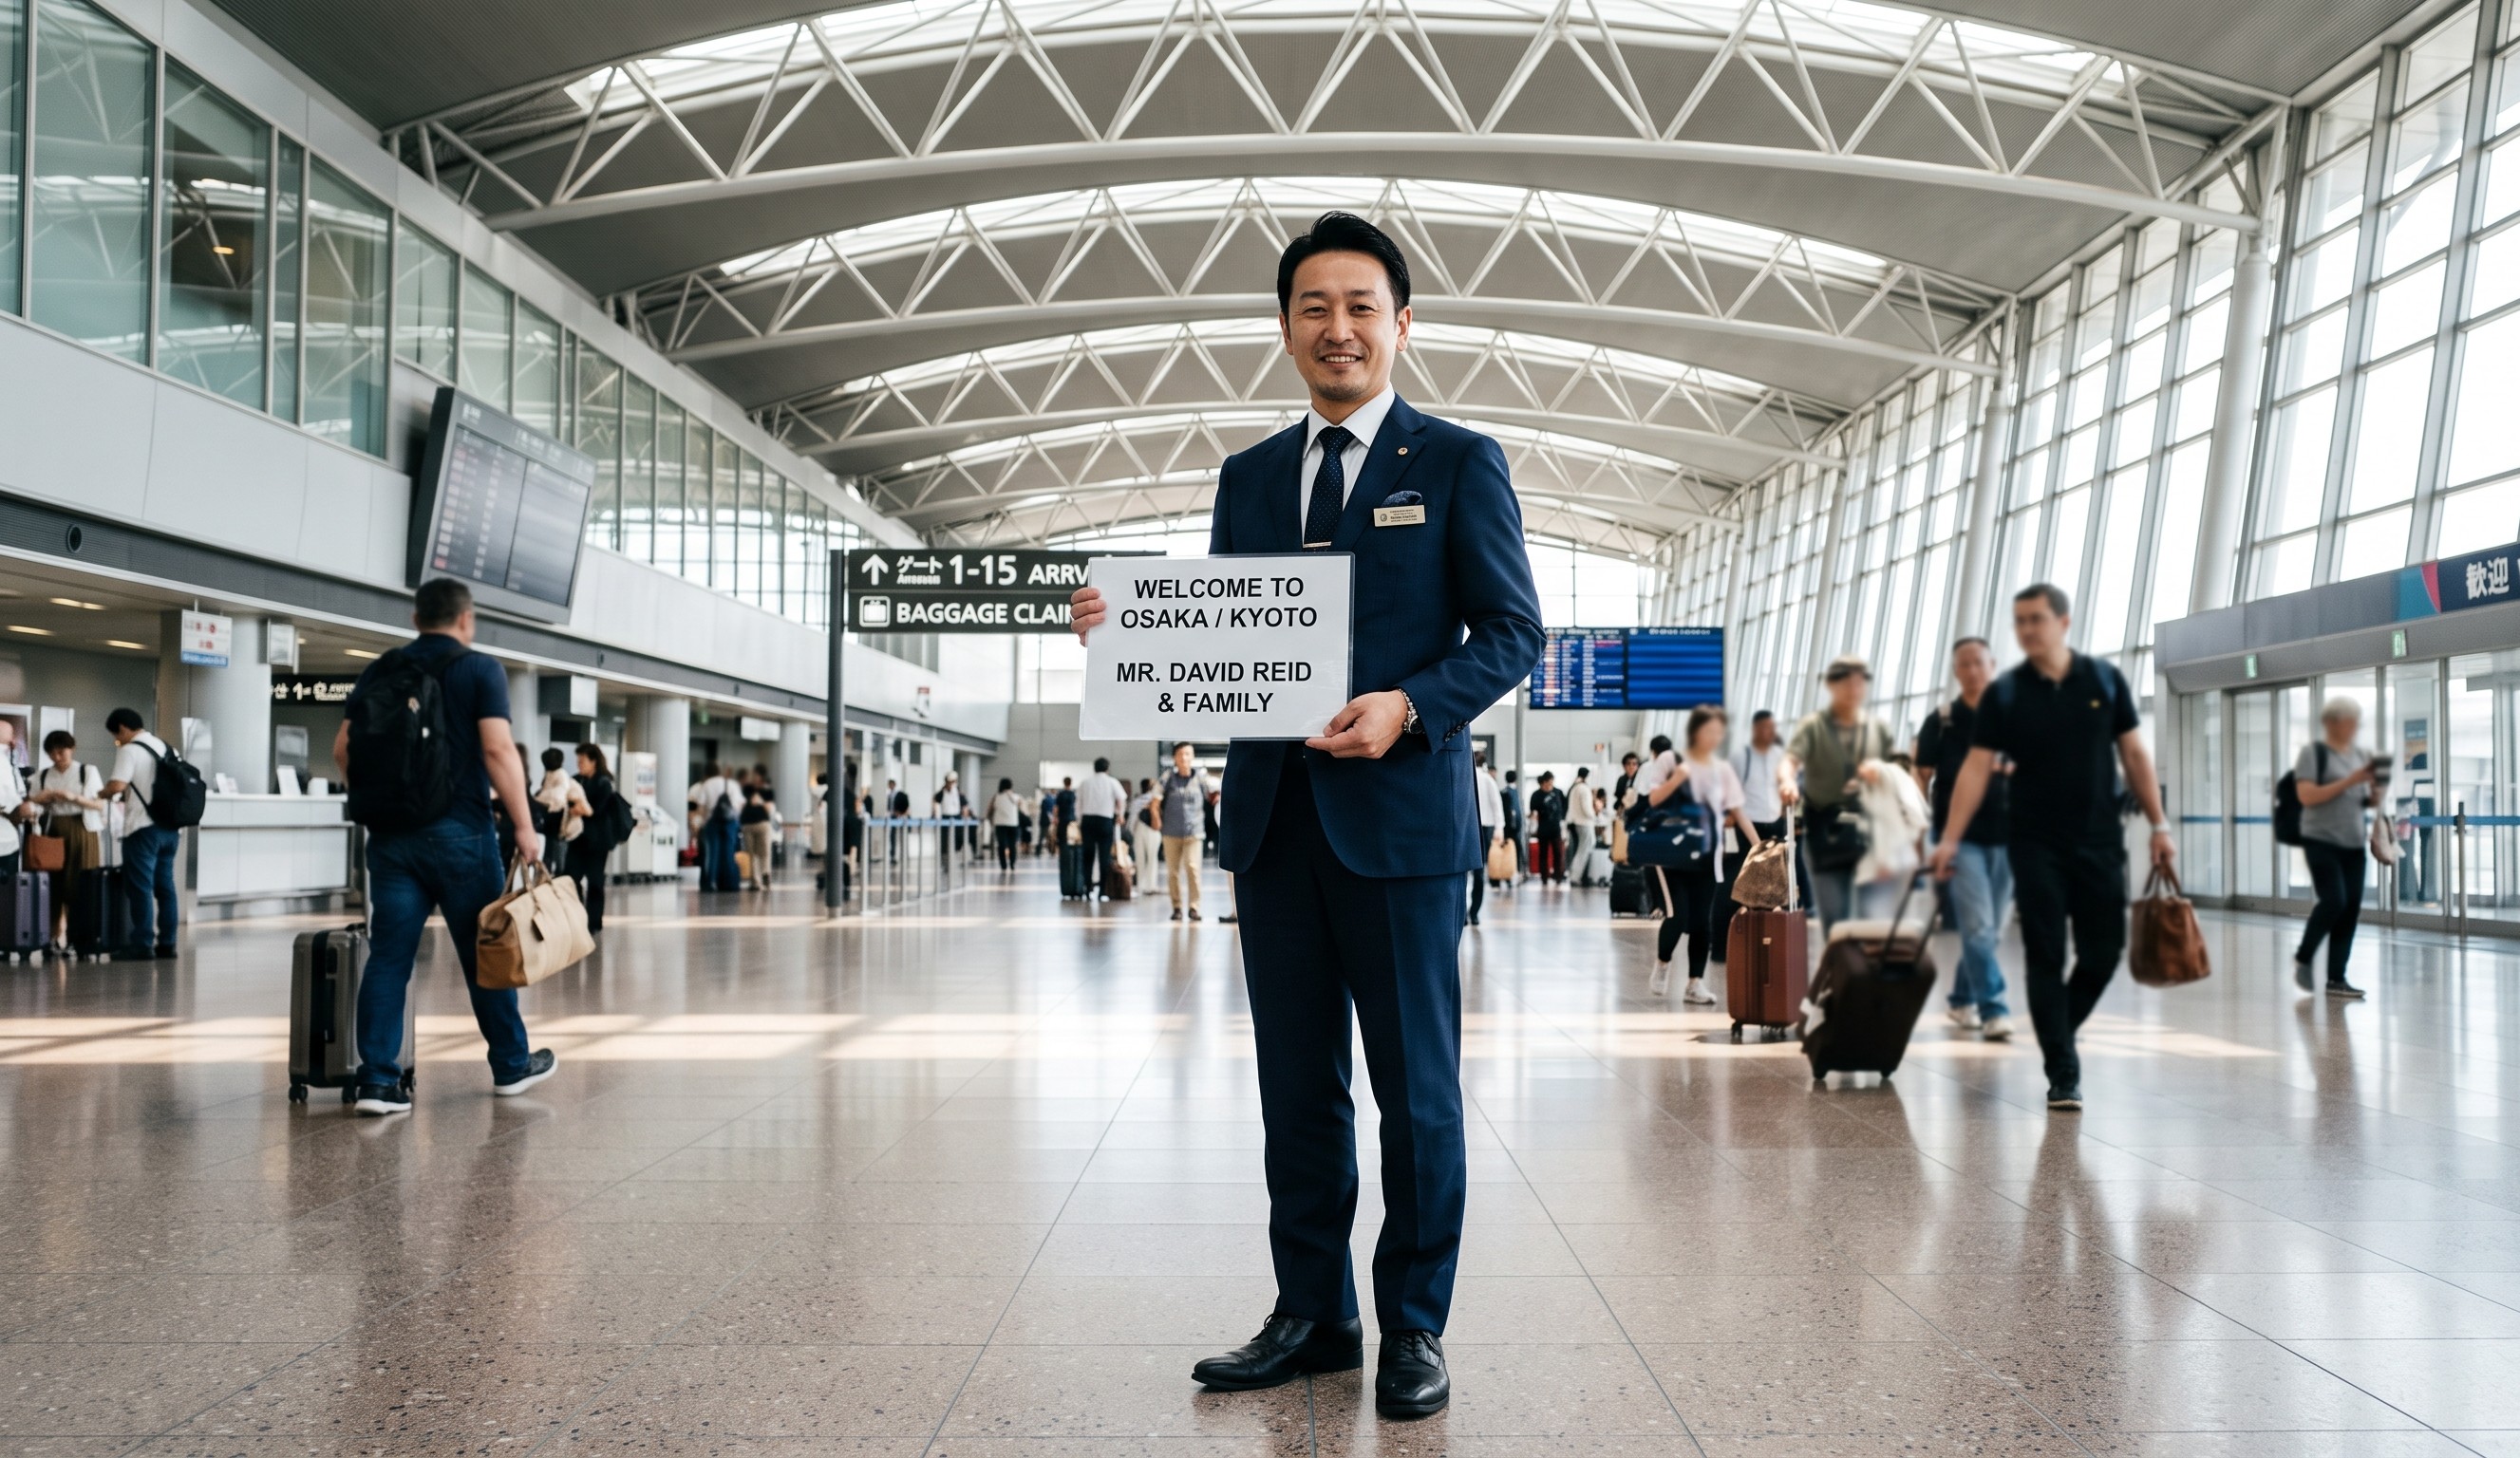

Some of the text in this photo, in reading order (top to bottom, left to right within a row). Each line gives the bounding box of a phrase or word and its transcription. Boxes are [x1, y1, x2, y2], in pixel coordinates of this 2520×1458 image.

[896, 555, 944, 574] ゲート
[949, 554, 1018, 586] 1-15
[1026, 564, 1088, 586] ARRV
[1134, 577, 1305, 599] WELCOME TO
[896, 603, 1008, 625] BAGGAGE
[1120, 607, 1318, 629] OSAKA / KYOTO
[1117, 662, 1312, 682] MR. DAVID REID
[1157, 692, 1274, 713] & FAMILY
